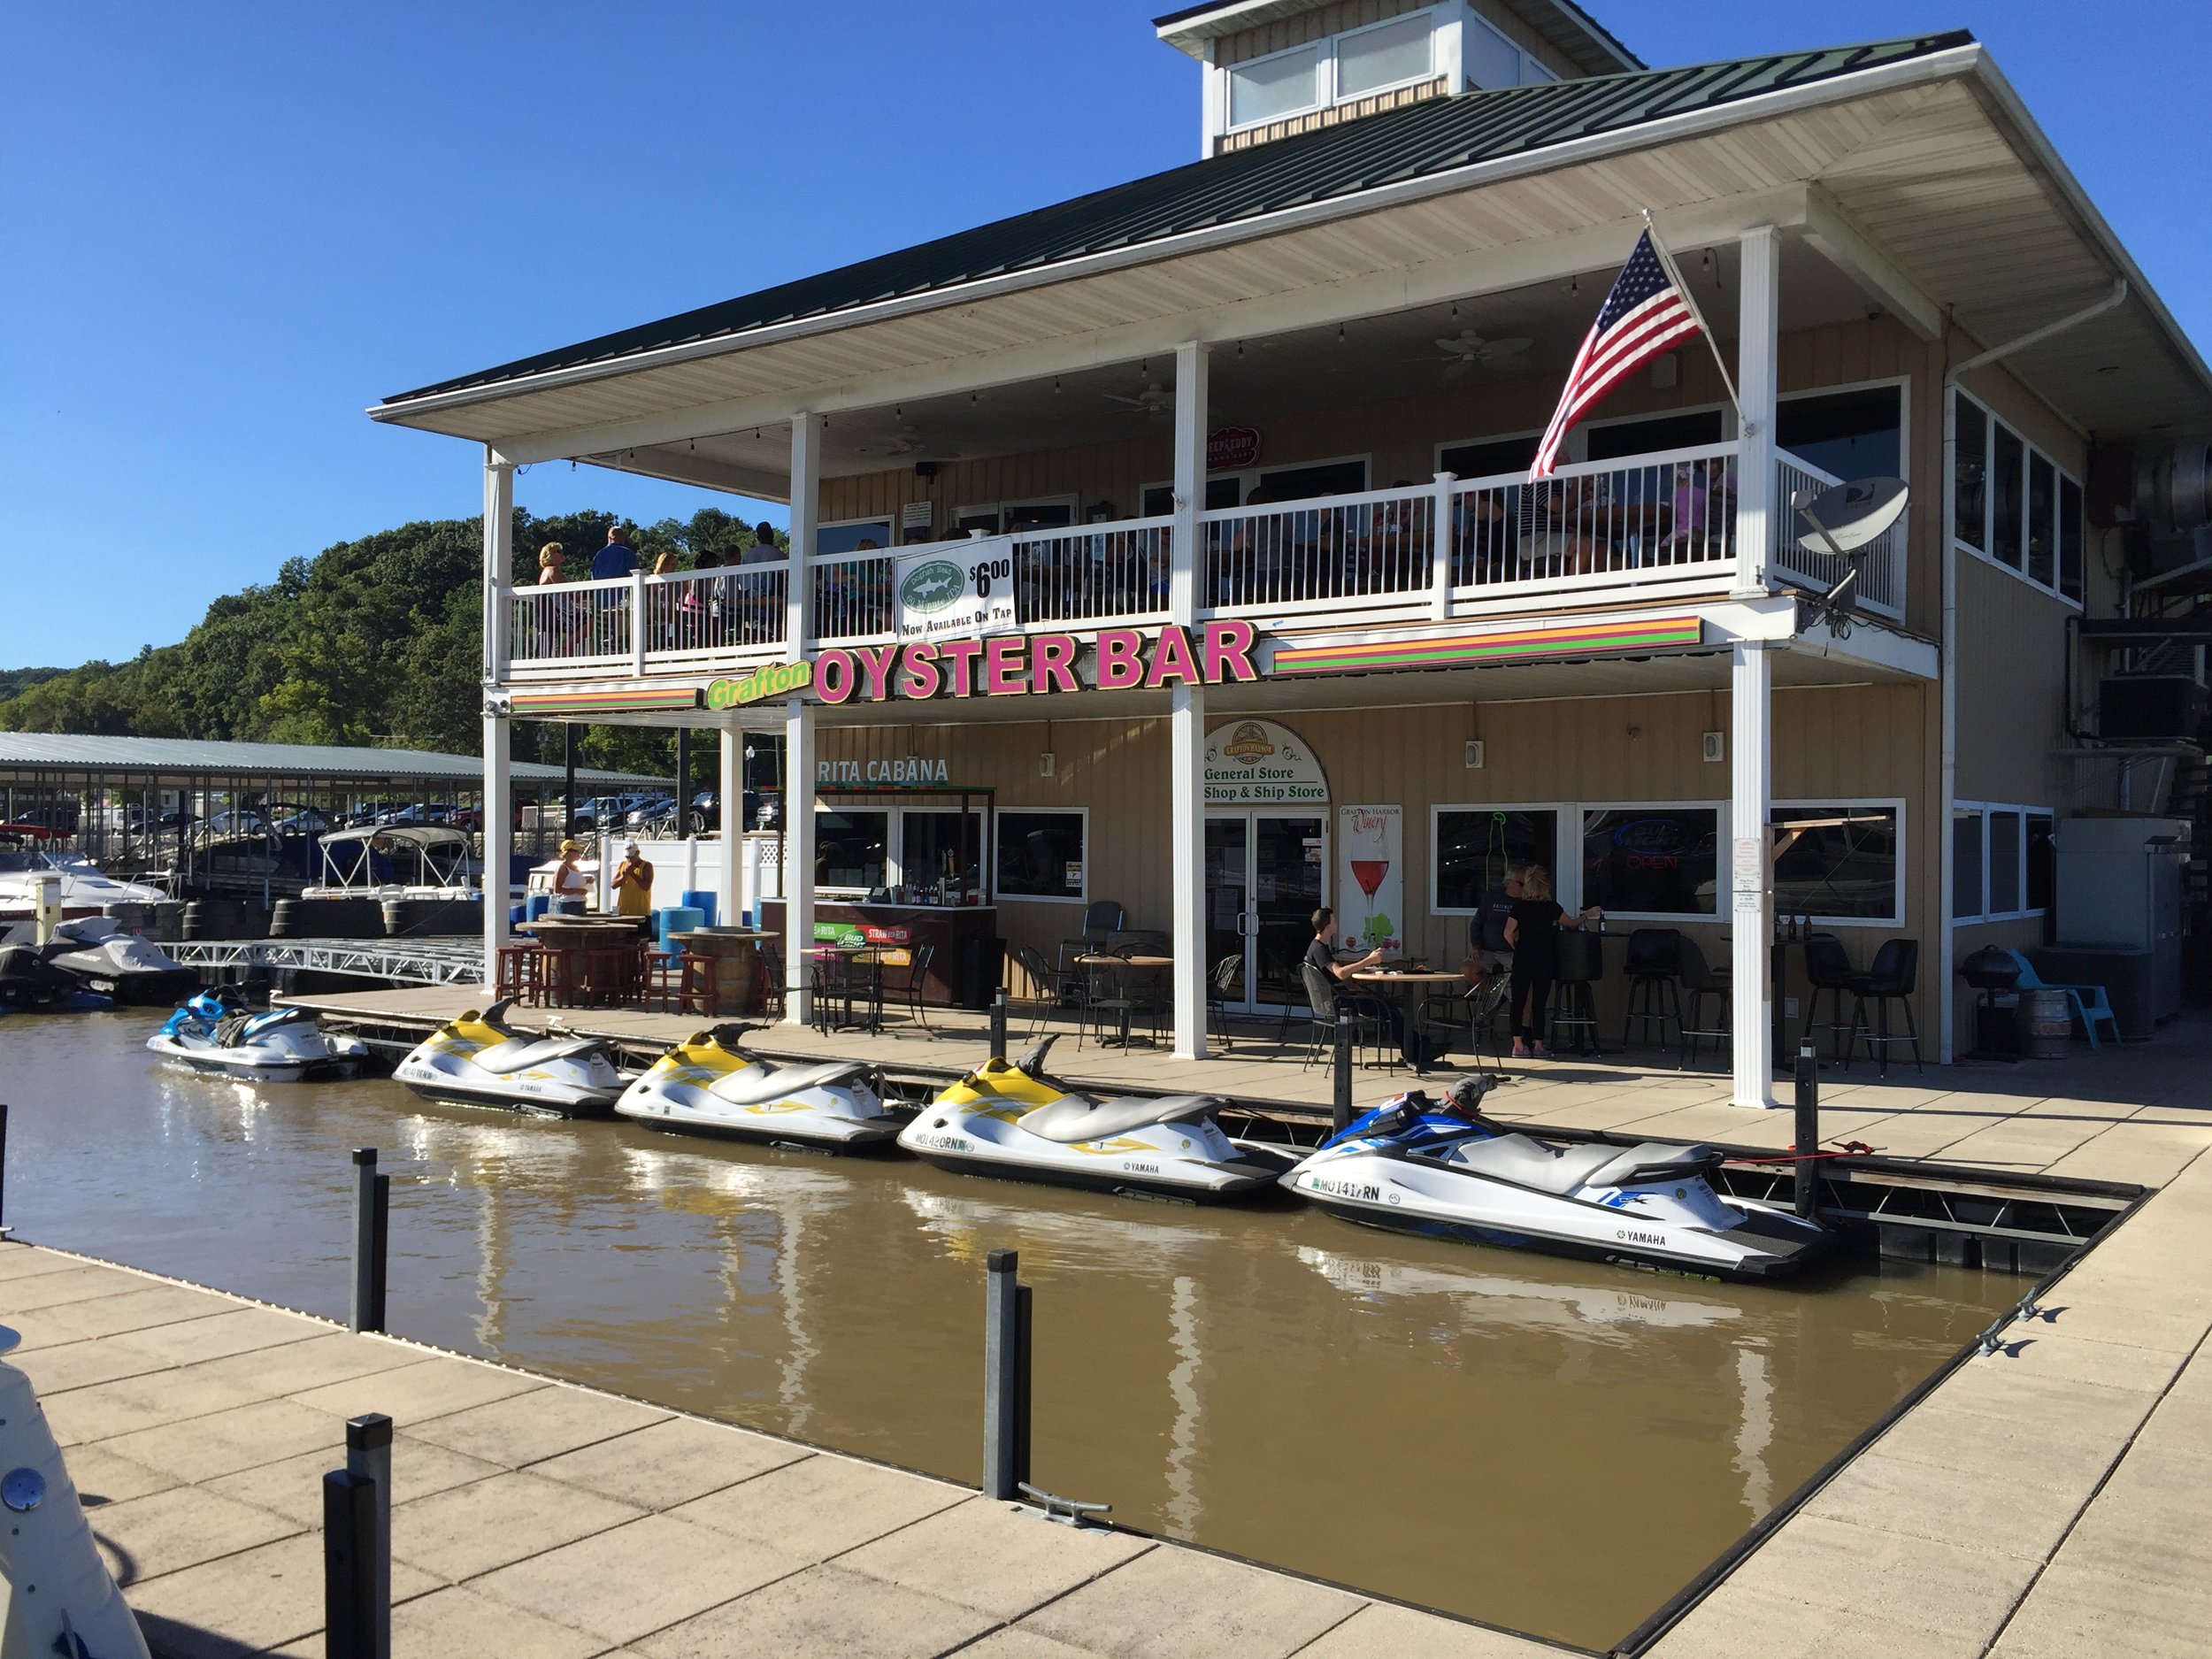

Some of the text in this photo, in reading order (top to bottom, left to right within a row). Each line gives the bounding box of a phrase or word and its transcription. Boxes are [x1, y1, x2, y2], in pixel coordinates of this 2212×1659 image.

[916, 598, 946, 611] Minute
[813, 619, 1259, 704] OYSTER BAR
[707, 663, 810, 710] Grafton
[818, 760, 861, 782] RITA
[1204, 767, 1294, 780] General Store
[1203, 785, 1325, 801] Shop & Ship Store
[1627, 856, 1678, 870] OPEN
[844, 933, 864, 942] BUD
[1131, 1162, 1160, 1174] YAMAHA
[1627, 1230, 1666, 1247] YAMAHA
